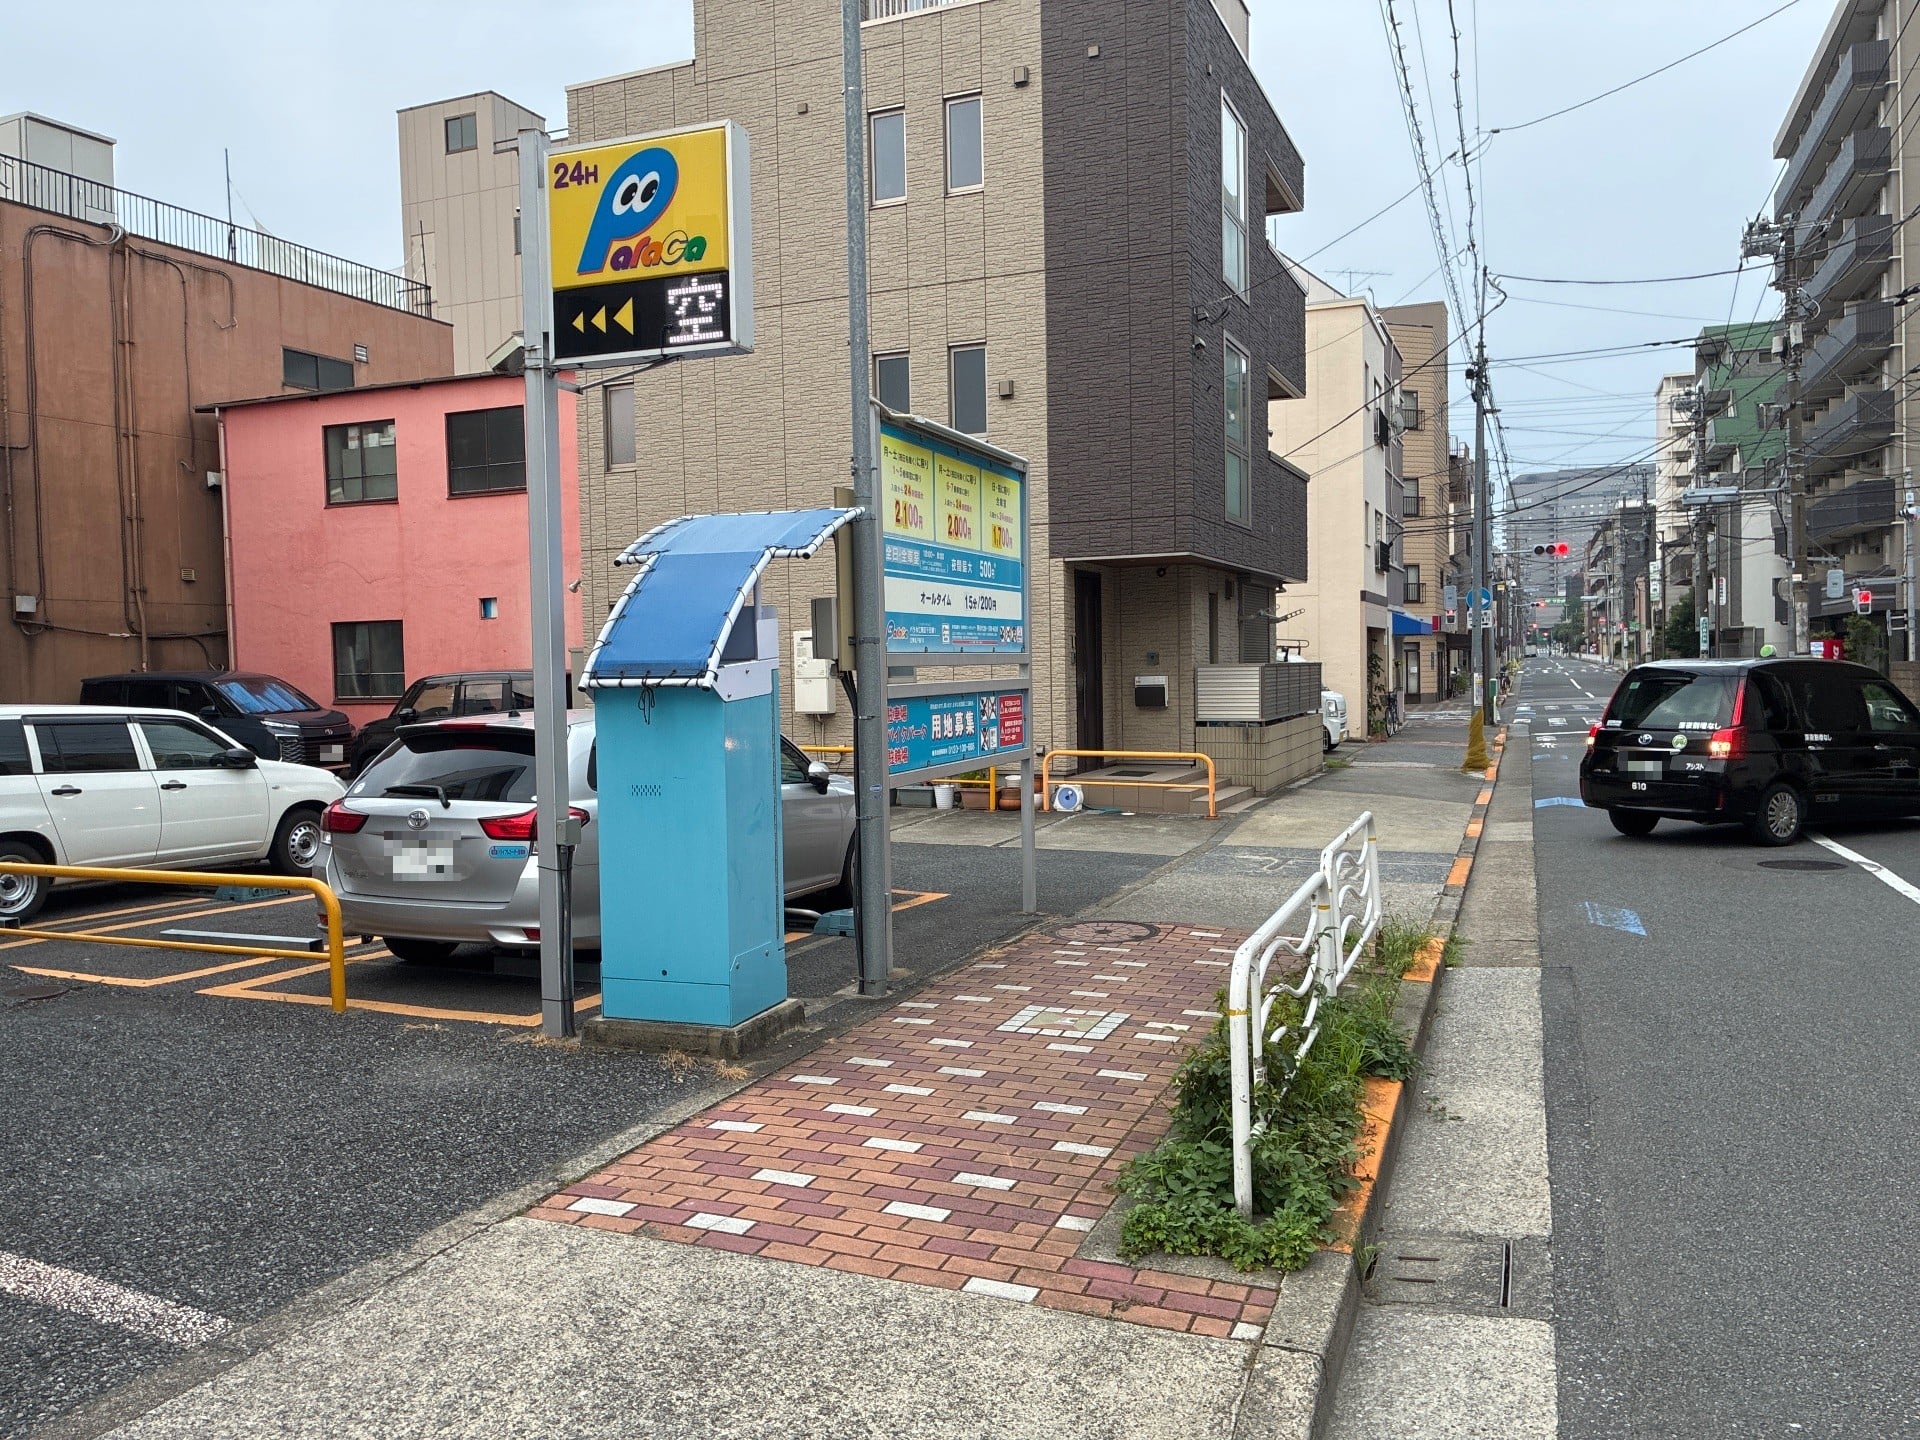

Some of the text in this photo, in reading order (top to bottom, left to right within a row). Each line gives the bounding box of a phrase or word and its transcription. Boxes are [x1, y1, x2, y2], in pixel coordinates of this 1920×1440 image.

[553, 160, 598, 189] 24H
[667, 278, 724, 344] 空
[920, 592, 997, 611] オールタイム 15分/200円
[931, 711, 975, 741] 用地募集
[1685, 762, 1705, 771] アシスト
[1631, 781, 1647, 791] 610
